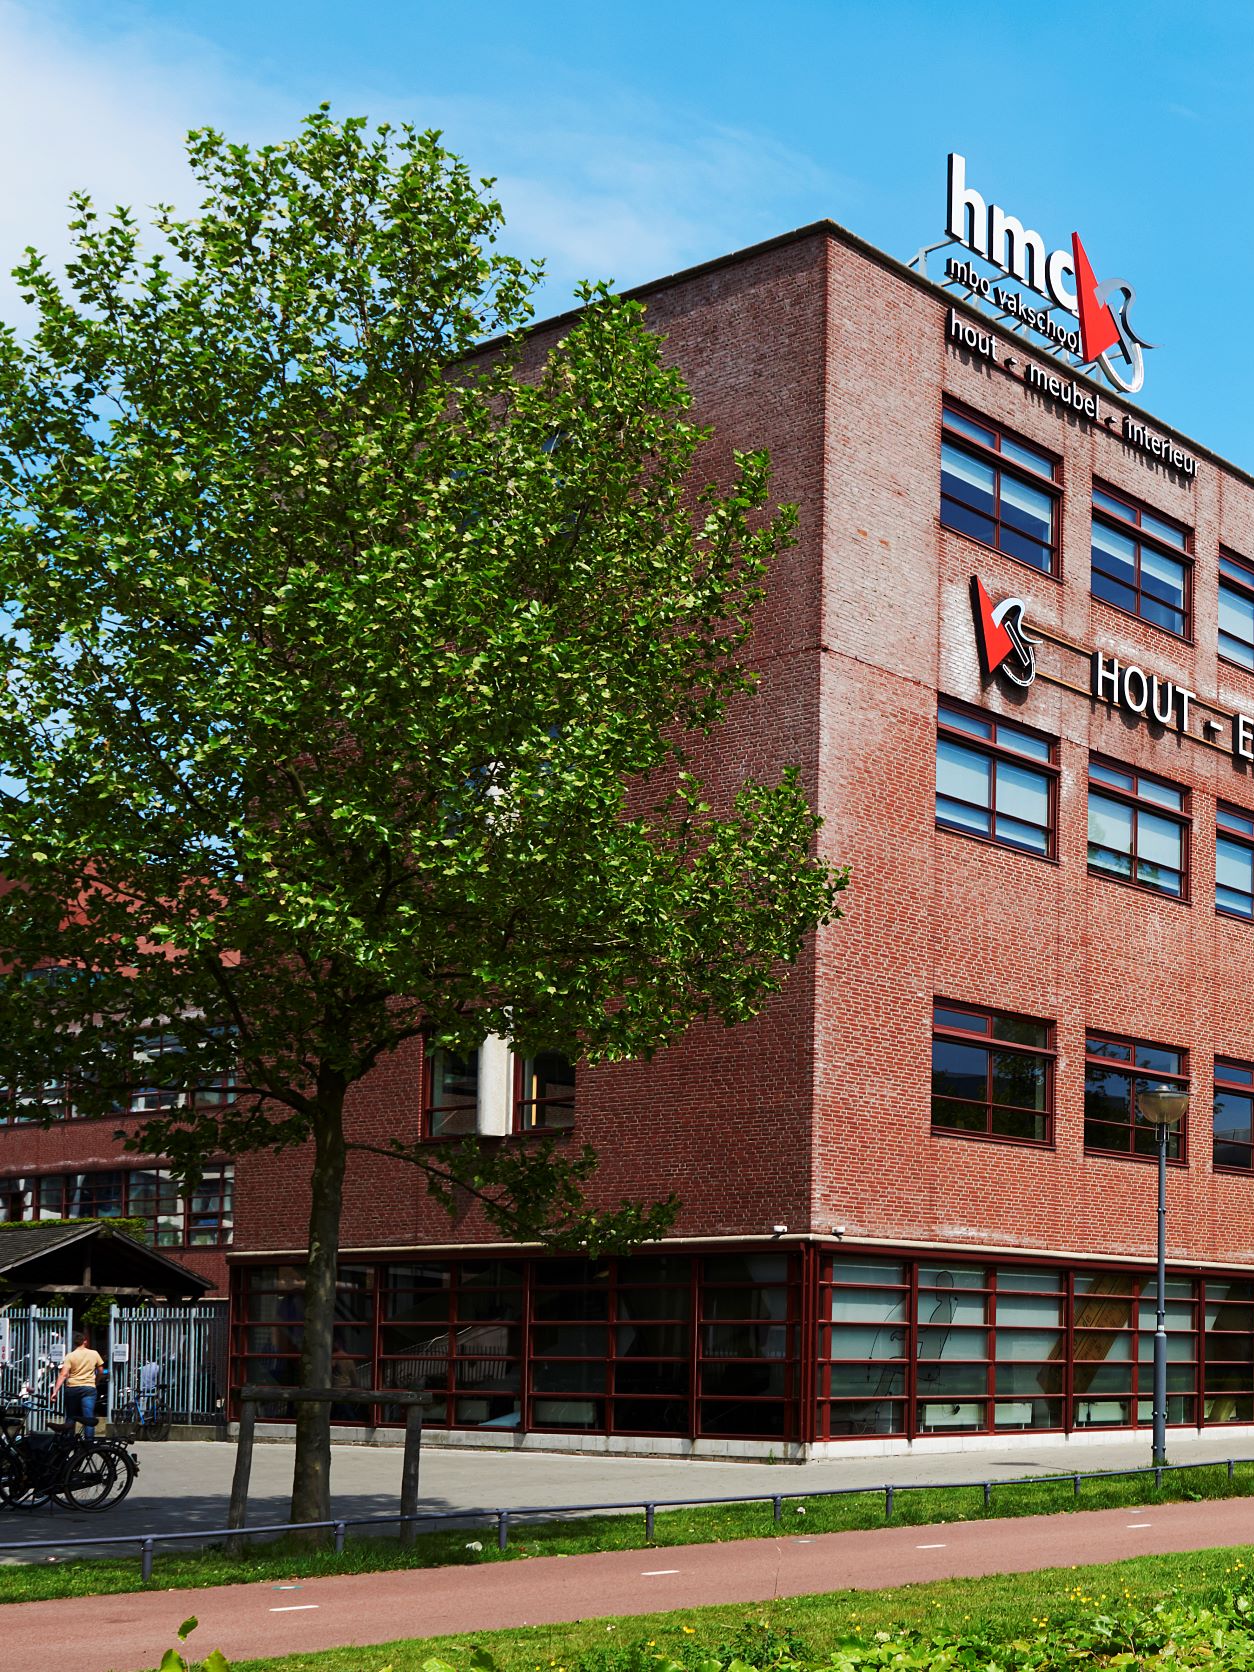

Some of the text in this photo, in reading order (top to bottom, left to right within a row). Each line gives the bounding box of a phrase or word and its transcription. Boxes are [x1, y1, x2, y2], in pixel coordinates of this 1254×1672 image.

[951, 152, 1079, 316] hmc
[952, 258, 1081, 352] mbo vakschool
[951, 308, 998, 362] hout
[1030, 363, 1100, 421] meubel
[1127, 414, 1200, 476] interieur
[1097, 651, 1196, 732] HOUT
